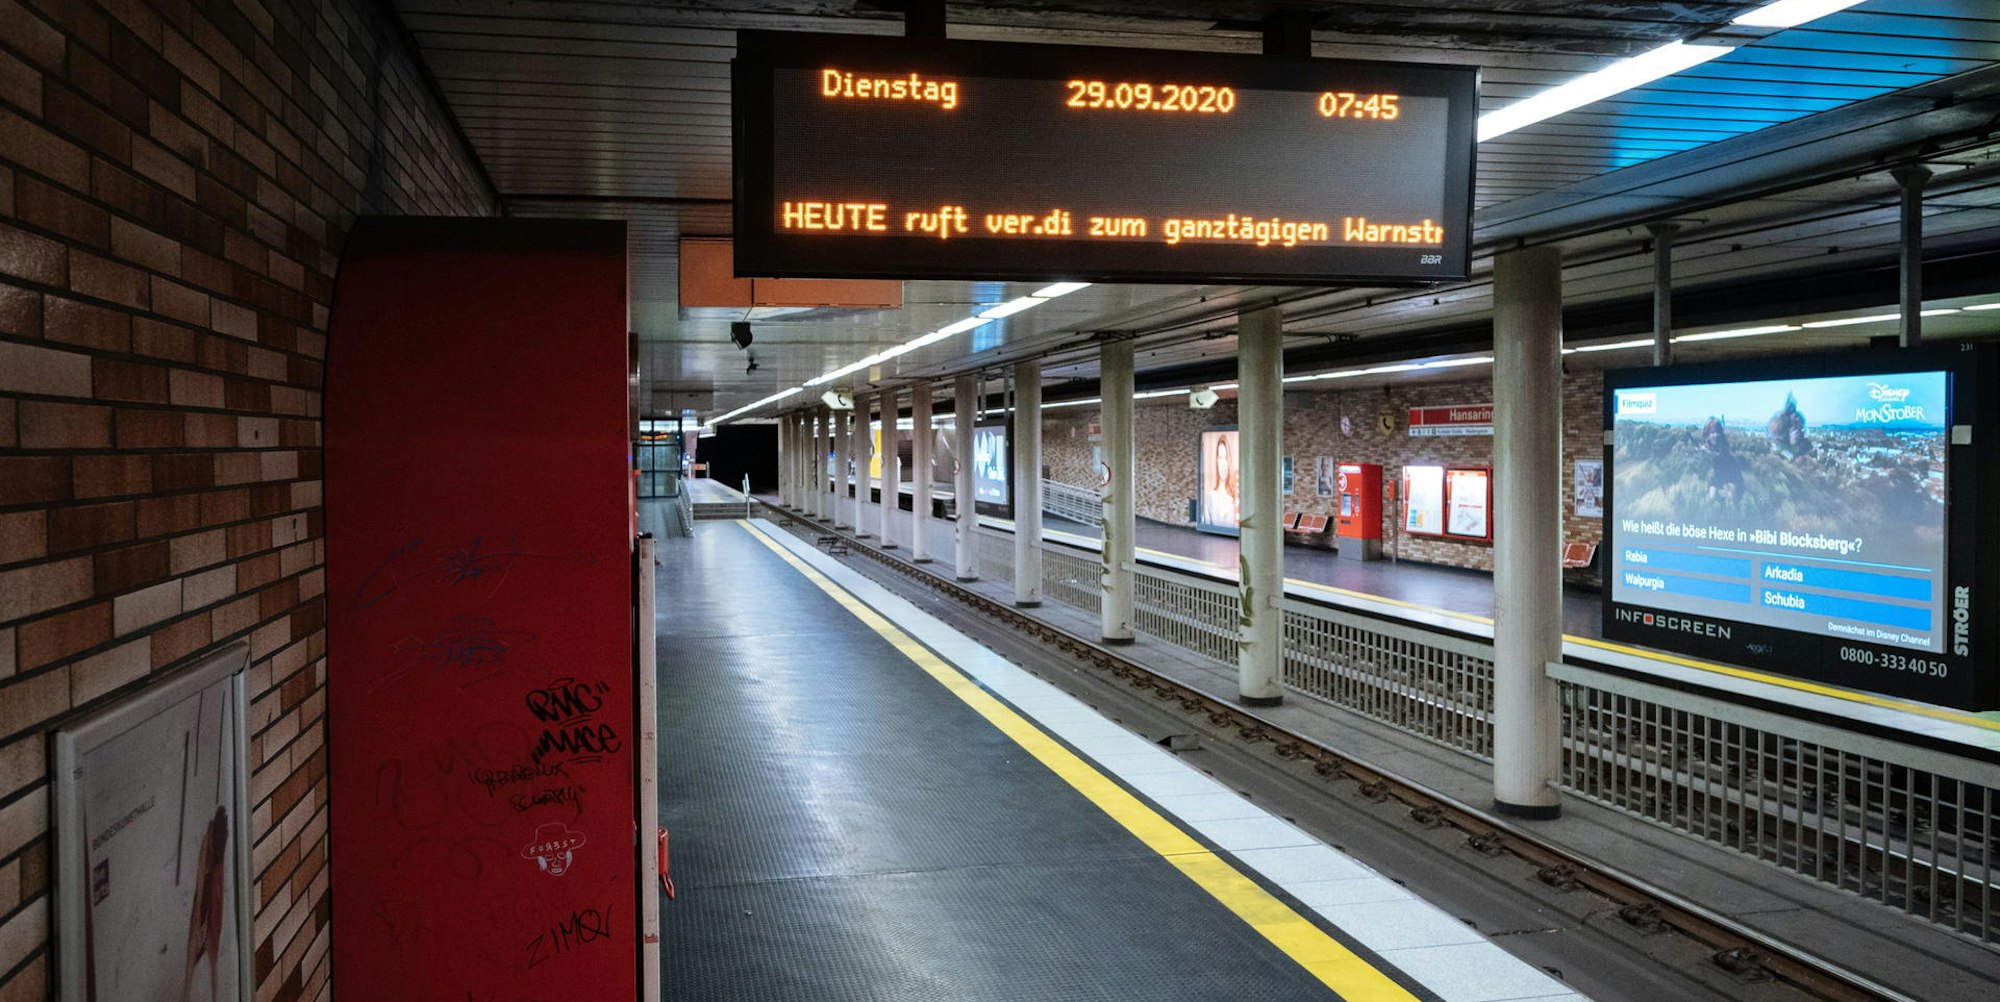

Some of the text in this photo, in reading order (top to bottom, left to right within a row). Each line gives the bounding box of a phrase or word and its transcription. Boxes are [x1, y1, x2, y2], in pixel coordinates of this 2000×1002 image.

[822, 68, 958, 110] Dienstag
[1066, 80, 1236, 114] 29.09.2020
[1318, 92, 1400, 120] 07:45
[783, 201, 888, 231] HEUTE
[905, 205, 969, 240] ruft
[985, 208, 1073, 236] ver.di
[1089, 216, 1148, 237] zum
[1163, 213, 1329, 247] ganztägigen
[1449, 407, 1494, 421] Hansarin
[1622, 399, 1654, 409] Filmquiz
[1622, 519, 1863, 555] Wie heißt die böse Hexe in »Bibi Blocksberg«?
[1625, 549, 1648, 564] Rabia
[1625, 572, 1665, 591] Walpurgia
[1764, 565, 1804, 582] Arkadia
[1764, 591, 1806, 609] Schubia
[1615, 607, 1732, 640] INFOSCREEN
[1828, 621, 1931, 647] Demnächst im Disney Channel
[1840, 646, 1948, 678] 0800-333 40 50
